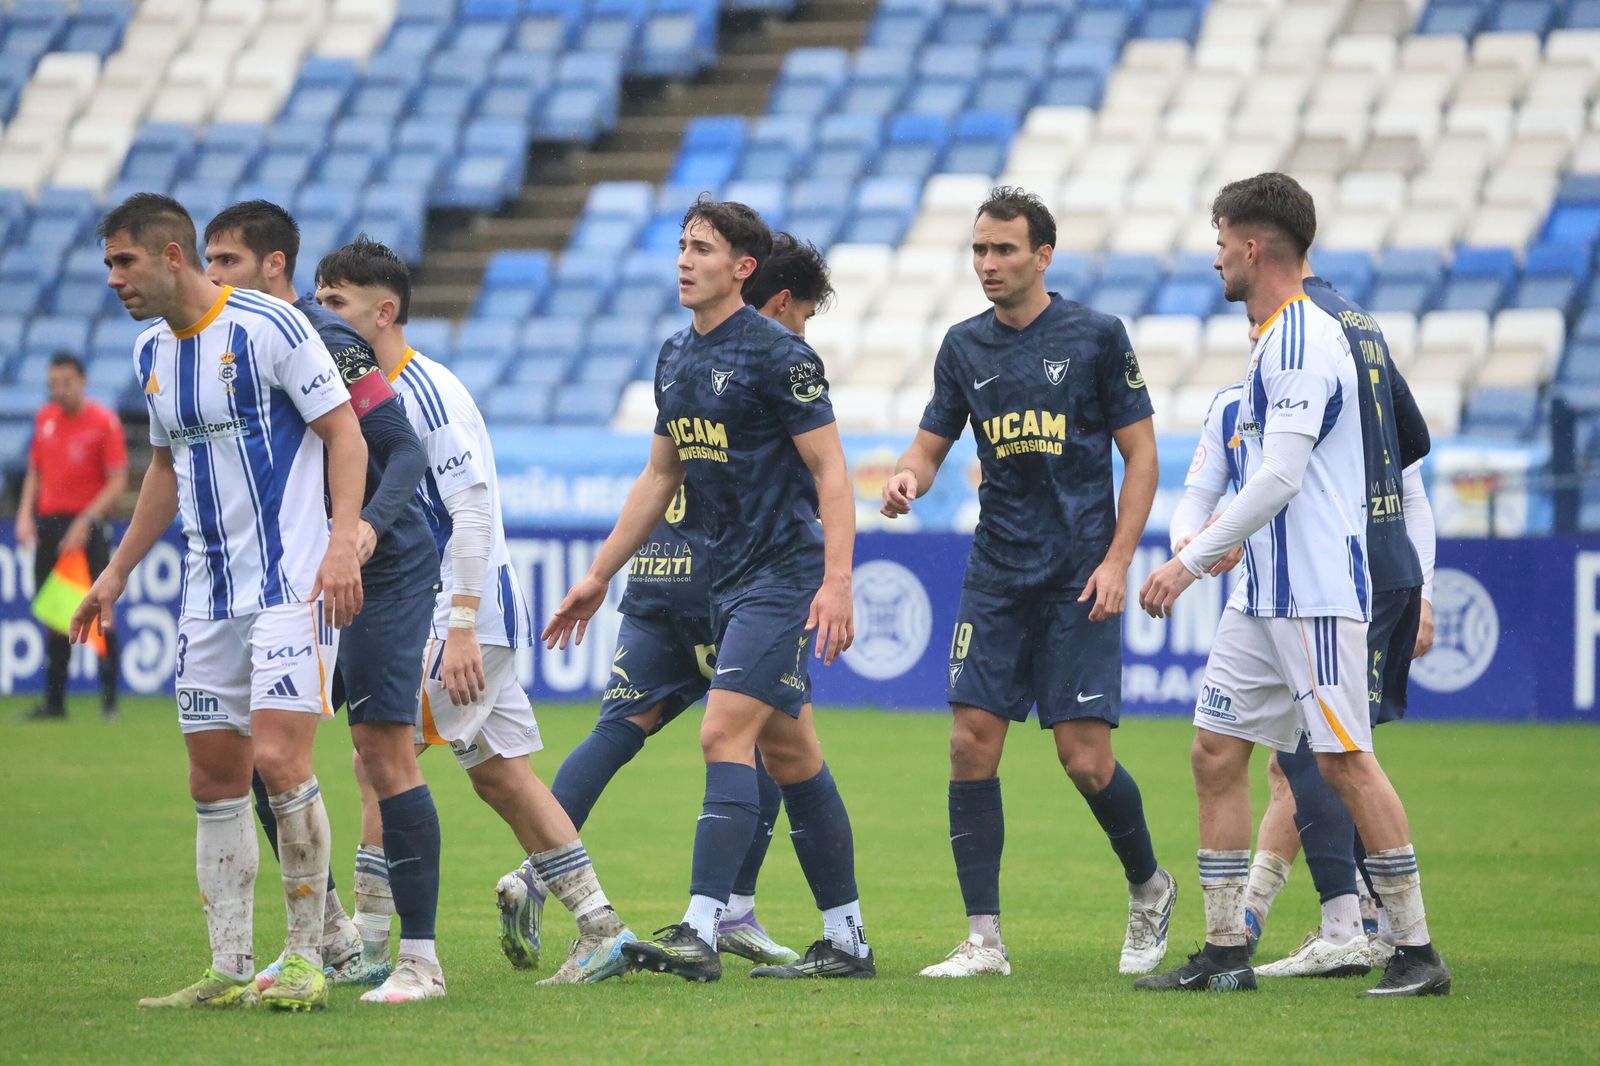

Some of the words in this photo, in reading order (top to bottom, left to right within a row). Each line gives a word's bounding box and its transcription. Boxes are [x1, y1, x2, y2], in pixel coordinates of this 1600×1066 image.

[666, 417, 728, 448] UCAM
[982, 409, 1066, 444] UCAM
[678, 446, 728, 463] NIVERSIDAD
[996, 440, 1063, 459] NIVERSIDAD
[638, 542, 692, 557] URCIA
[178, 691, 219, 712] Olin
[1201, 685, 1232, 712] Olin
